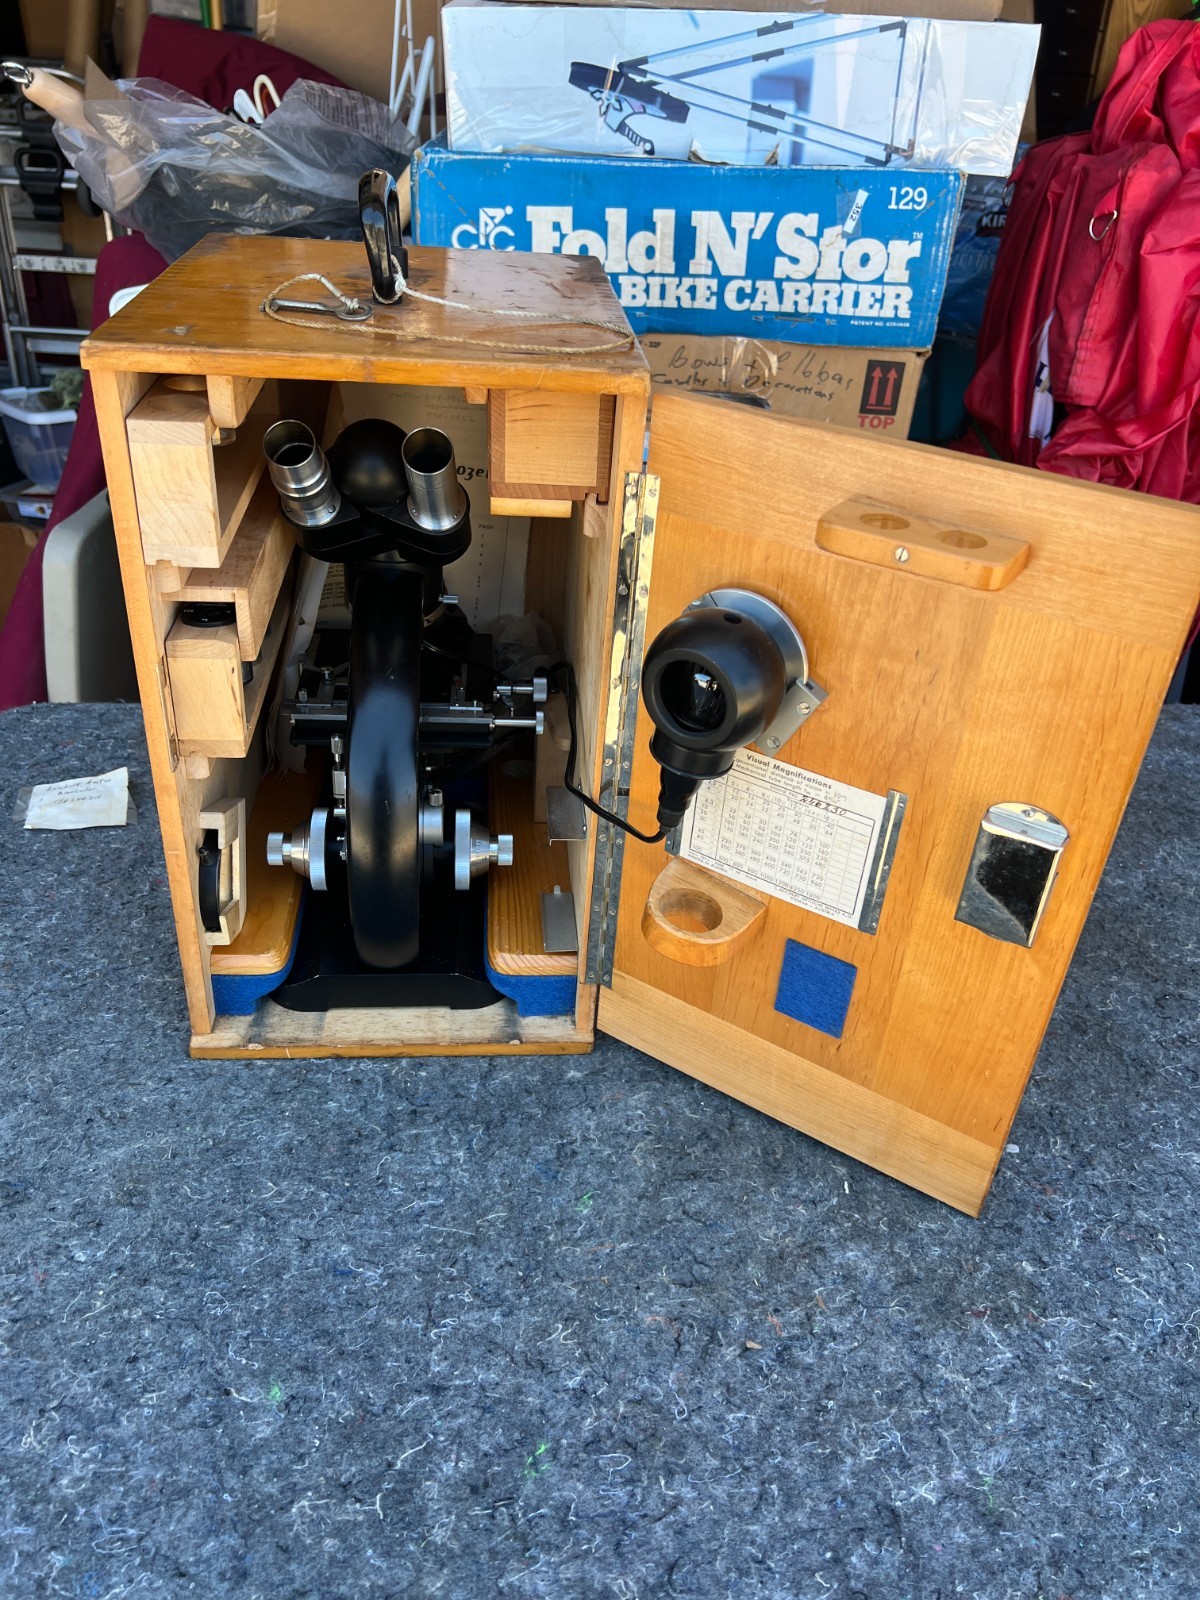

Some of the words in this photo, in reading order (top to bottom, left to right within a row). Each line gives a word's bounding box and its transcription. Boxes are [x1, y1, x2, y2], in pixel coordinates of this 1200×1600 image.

[888, 187, 928, 211] 129
[526, 205, 676, 275] Fold
[689, 211, 775, 276] N'
[774, 213, 922, 282] Stor
[618, 276, 717, 309] BIKE
[724, 278, 912, 318] CARRIER
[858, 415, 895, 429] TOP
[735, 763, 766, 778] Mechanical
[783, 780, 802, 792] length
[746, 753, 769, 767] Visual
[772, 763, 832, 791] Magnifications
